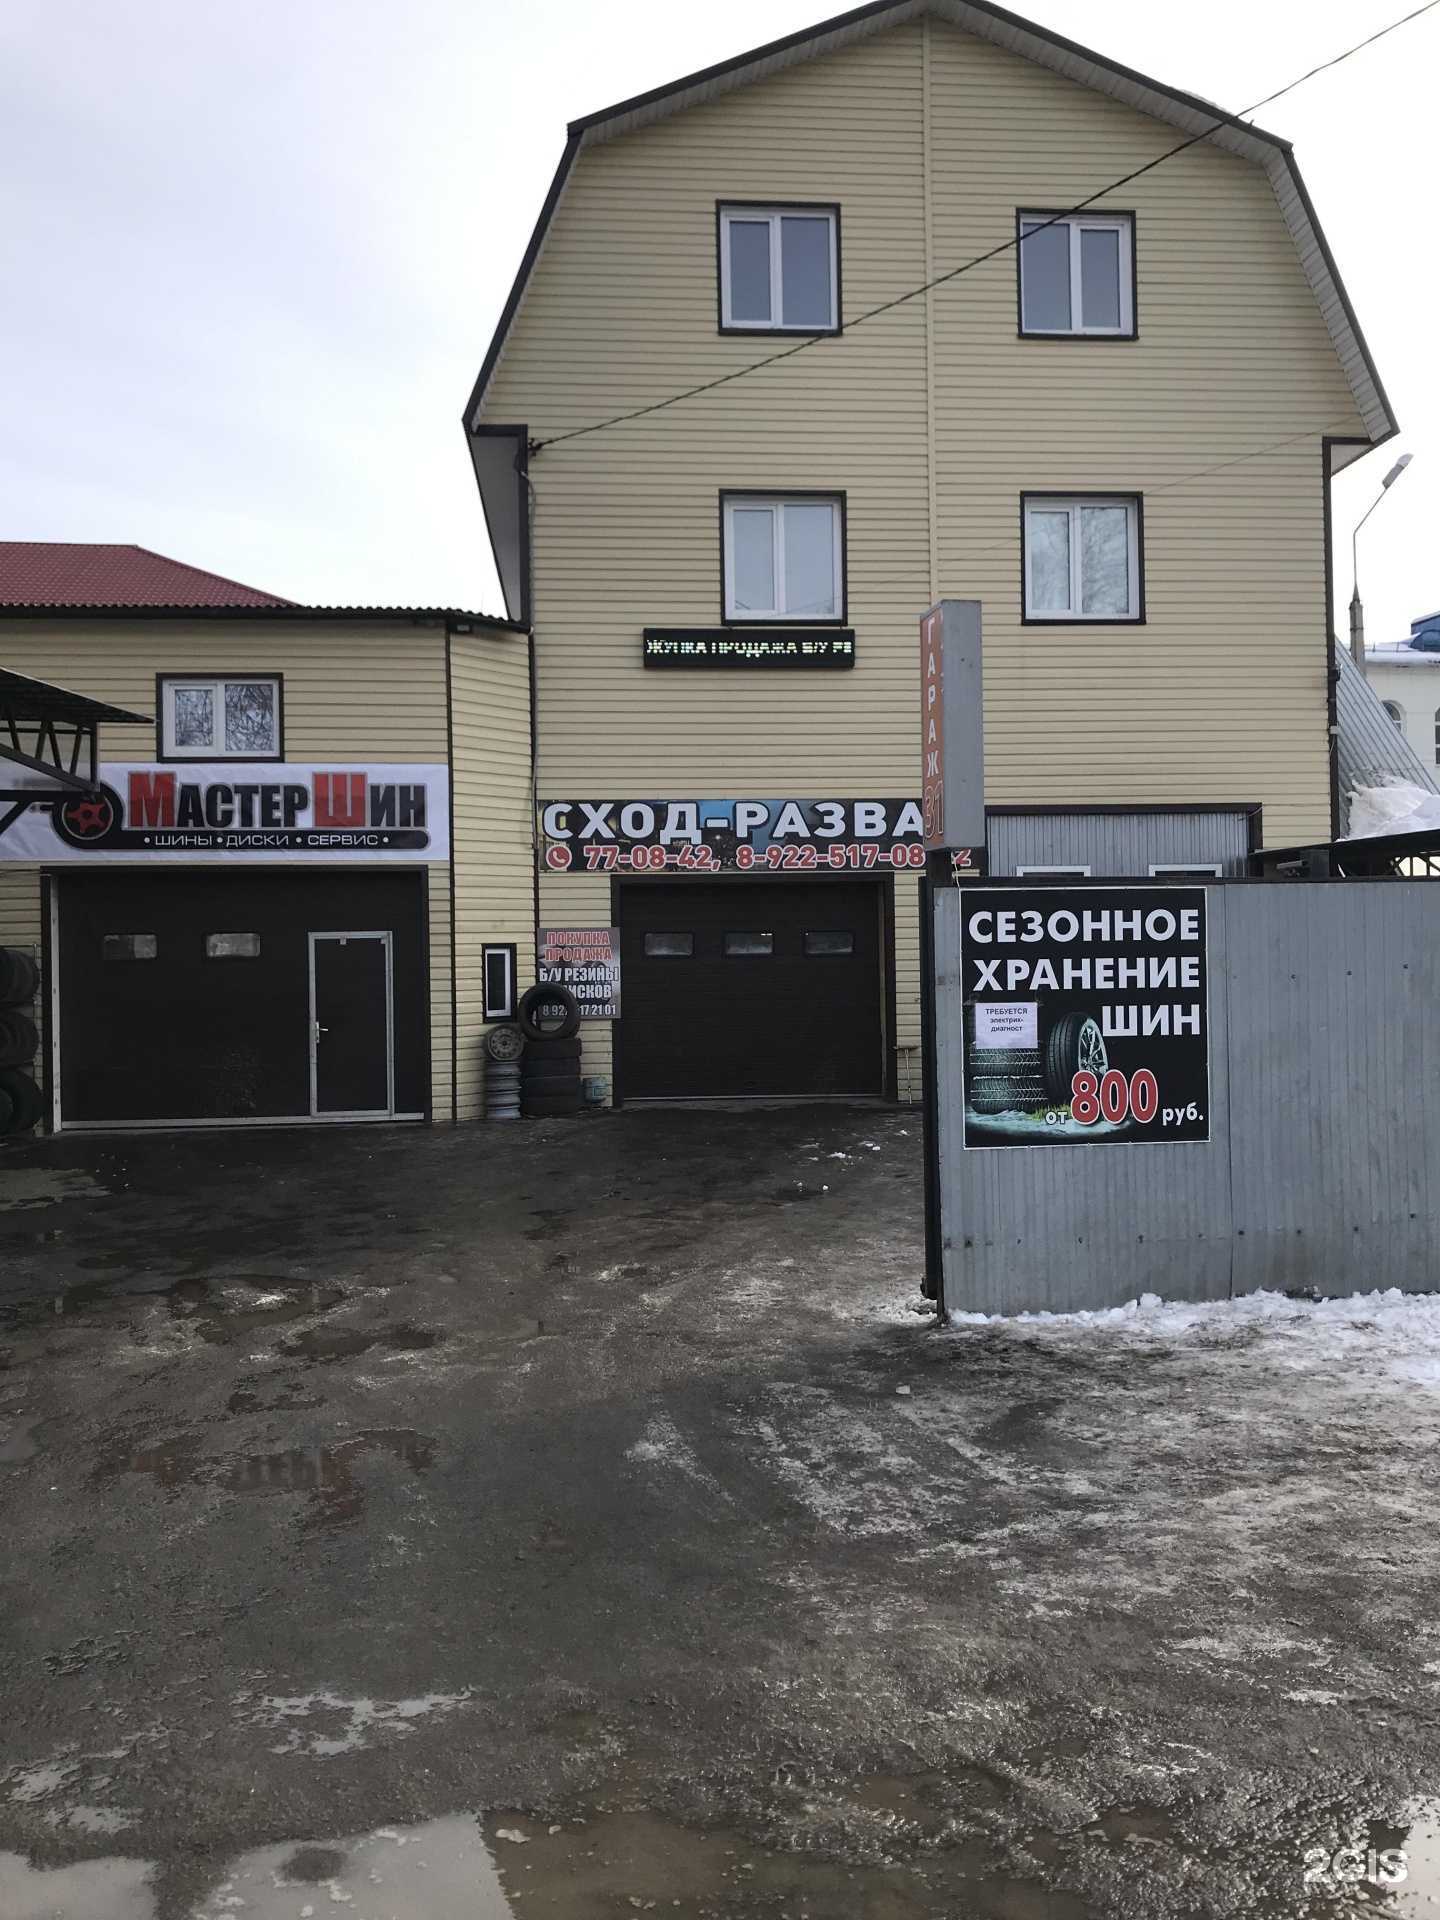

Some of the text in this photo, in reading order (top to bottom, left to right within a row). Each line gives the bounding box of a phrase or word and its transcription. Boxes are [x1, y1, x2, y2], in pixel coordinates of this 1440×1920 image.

[927, 617, 940, 778] ГАРАЖ
[924, 781, 944, 838] 31
[155, 835, 379, 848] ШИНЫ ДИСКИ СЕРВИС
[546, 931, 610, 945] ПОКУПКА
[968, 909, 1199, 944] СЕЗОННОЕ
[544, 947, 612, 963] ПРОДАЖА
[540, 967, 620, 982] Б/У РЕЗИНЫ
[972, 956, 1200, 991] ХРАНЕНИЕ
[564, 984, 612, 999] ИСКОВ
[552, 1004, 567, 1016] 92
[1102, 1004, 1200, 1037] ШИН
[1045, 1068, 1204, 1126] от 800 руб.
